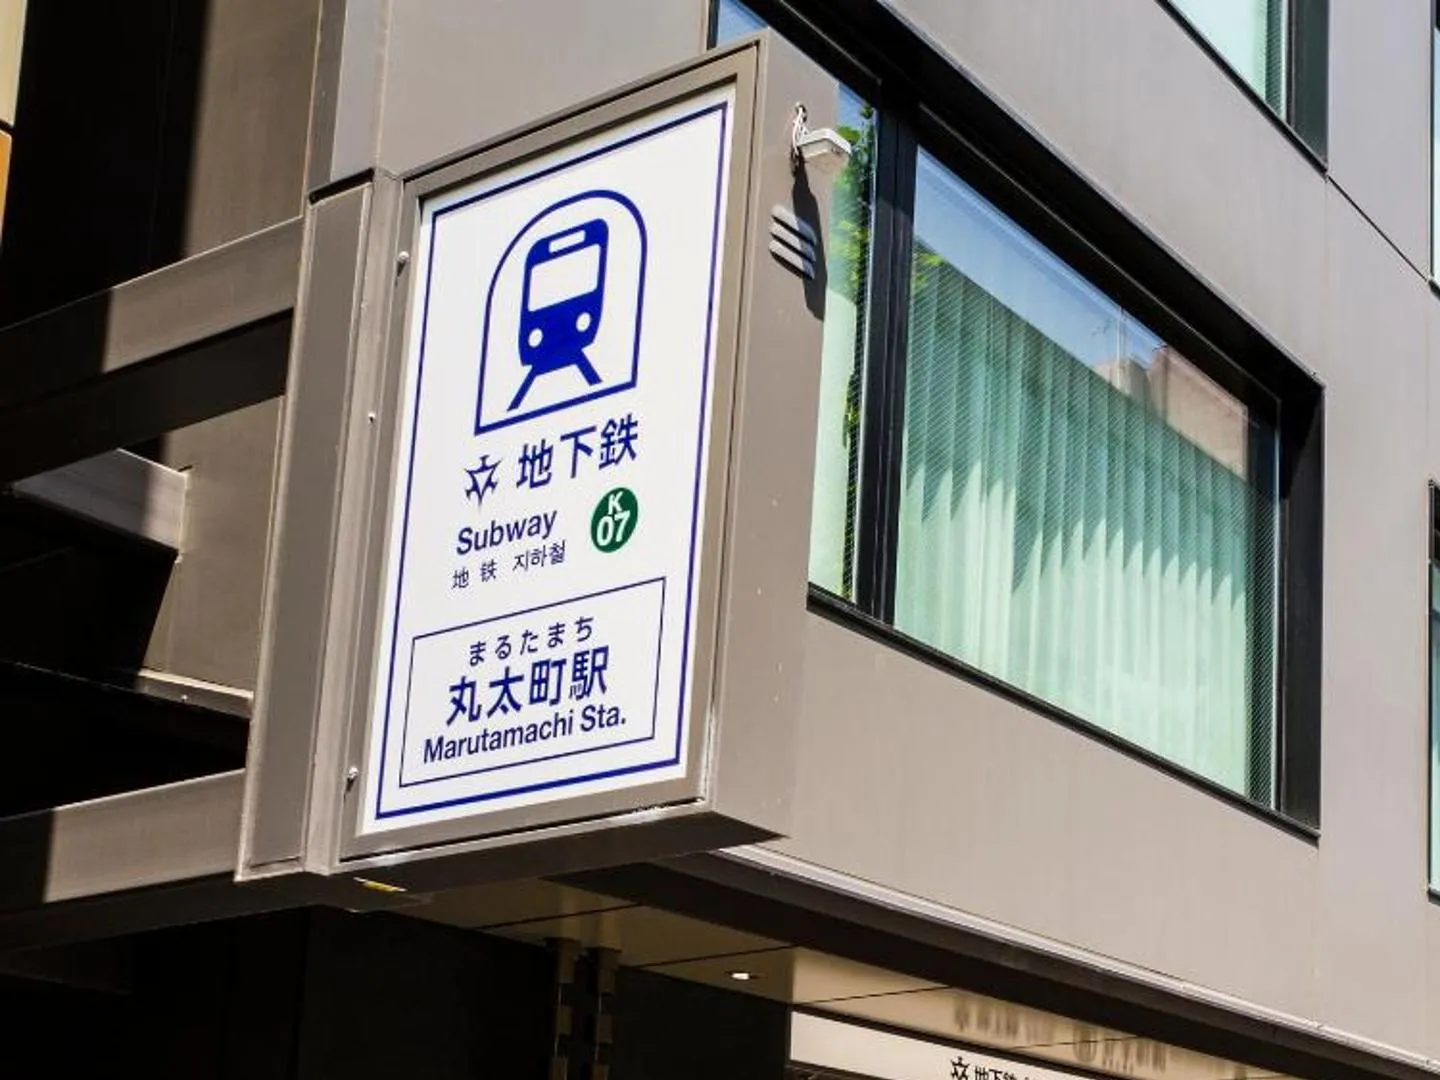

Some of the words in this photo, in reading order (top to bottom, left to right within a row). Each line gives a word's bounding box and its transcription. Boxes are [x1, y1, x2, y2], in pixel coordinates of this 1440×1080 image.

[515, 414, 639, 489] 地下鉄
[596, 511, 633, 545] 07
[607, 493, 622, 516] K
[456, 509, 557, 555] Subway
[512, 540, 566, 572] 지하철
[469, 615, 594, 667] まるたまち
[446, 645, 610, 726] 丸太町駅
[423, 711, 574, 764] Marutamachi
[580, 703, 627, 733] Sta.
